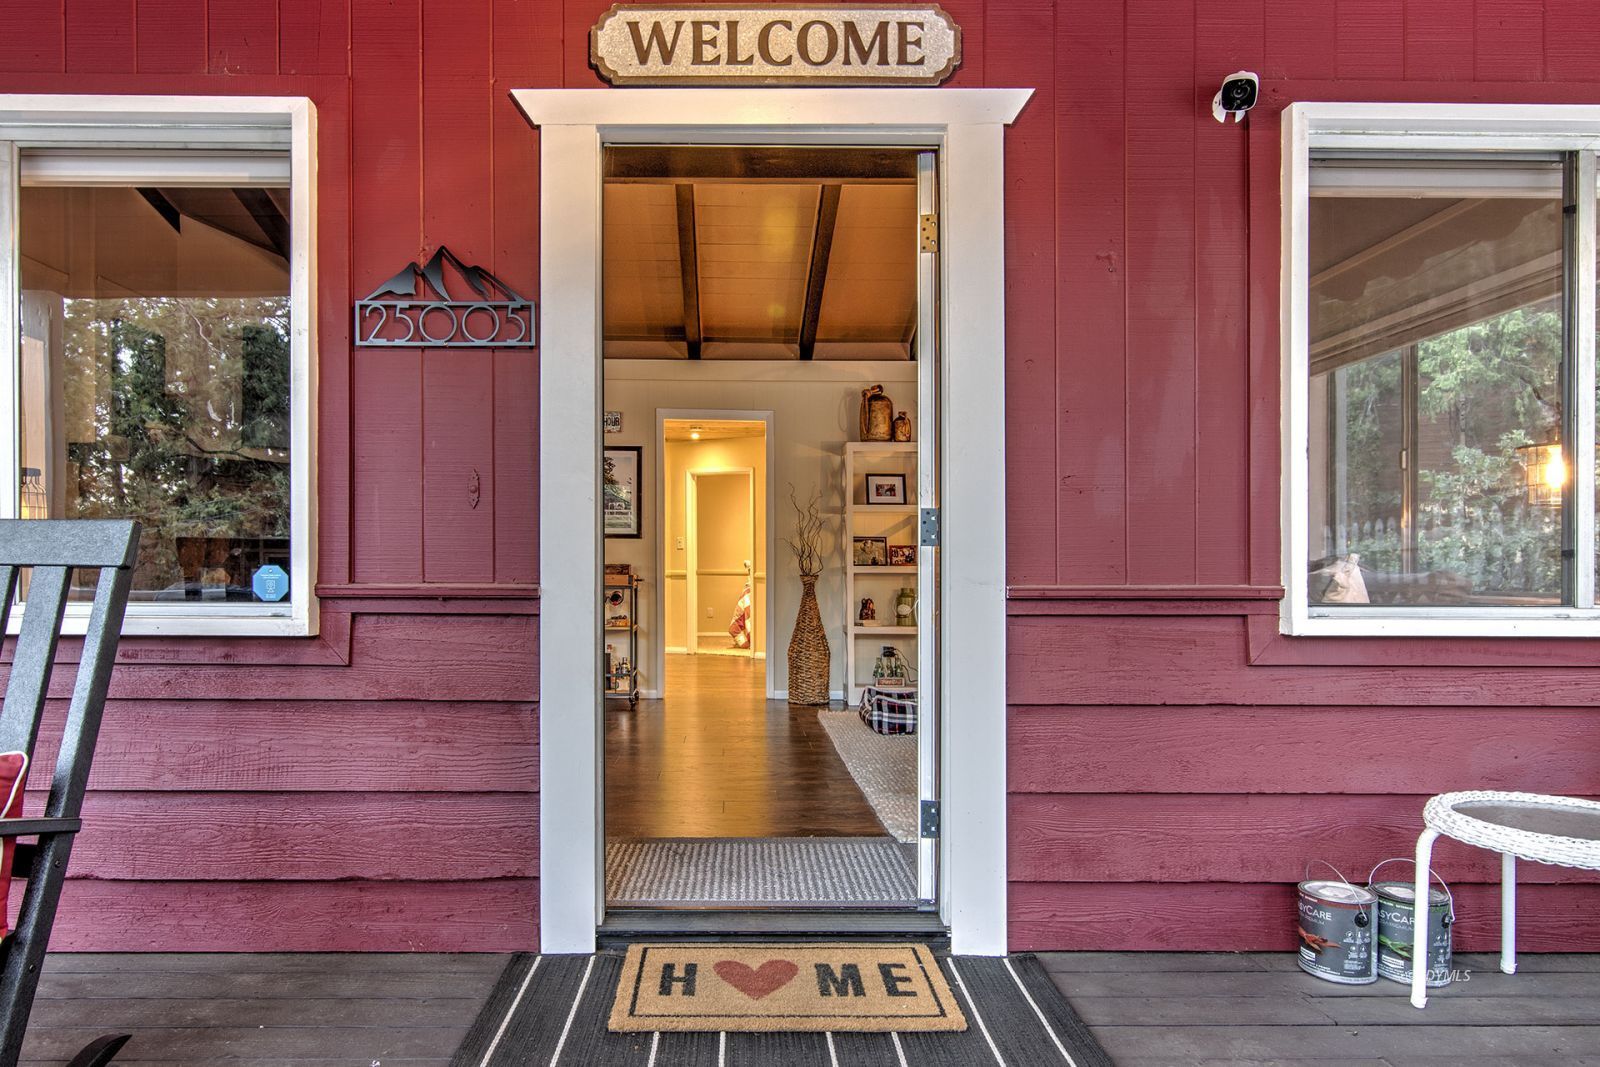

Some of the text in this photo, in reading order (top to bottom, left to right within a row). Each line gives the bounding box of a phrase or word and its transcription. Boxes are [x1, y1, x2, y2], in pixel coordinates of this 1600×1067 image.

[625, 19, 926, 67] WELCOME
[365, 303, 526, 342] 25005
[1298, 902, 1332, 921] SYCARE
